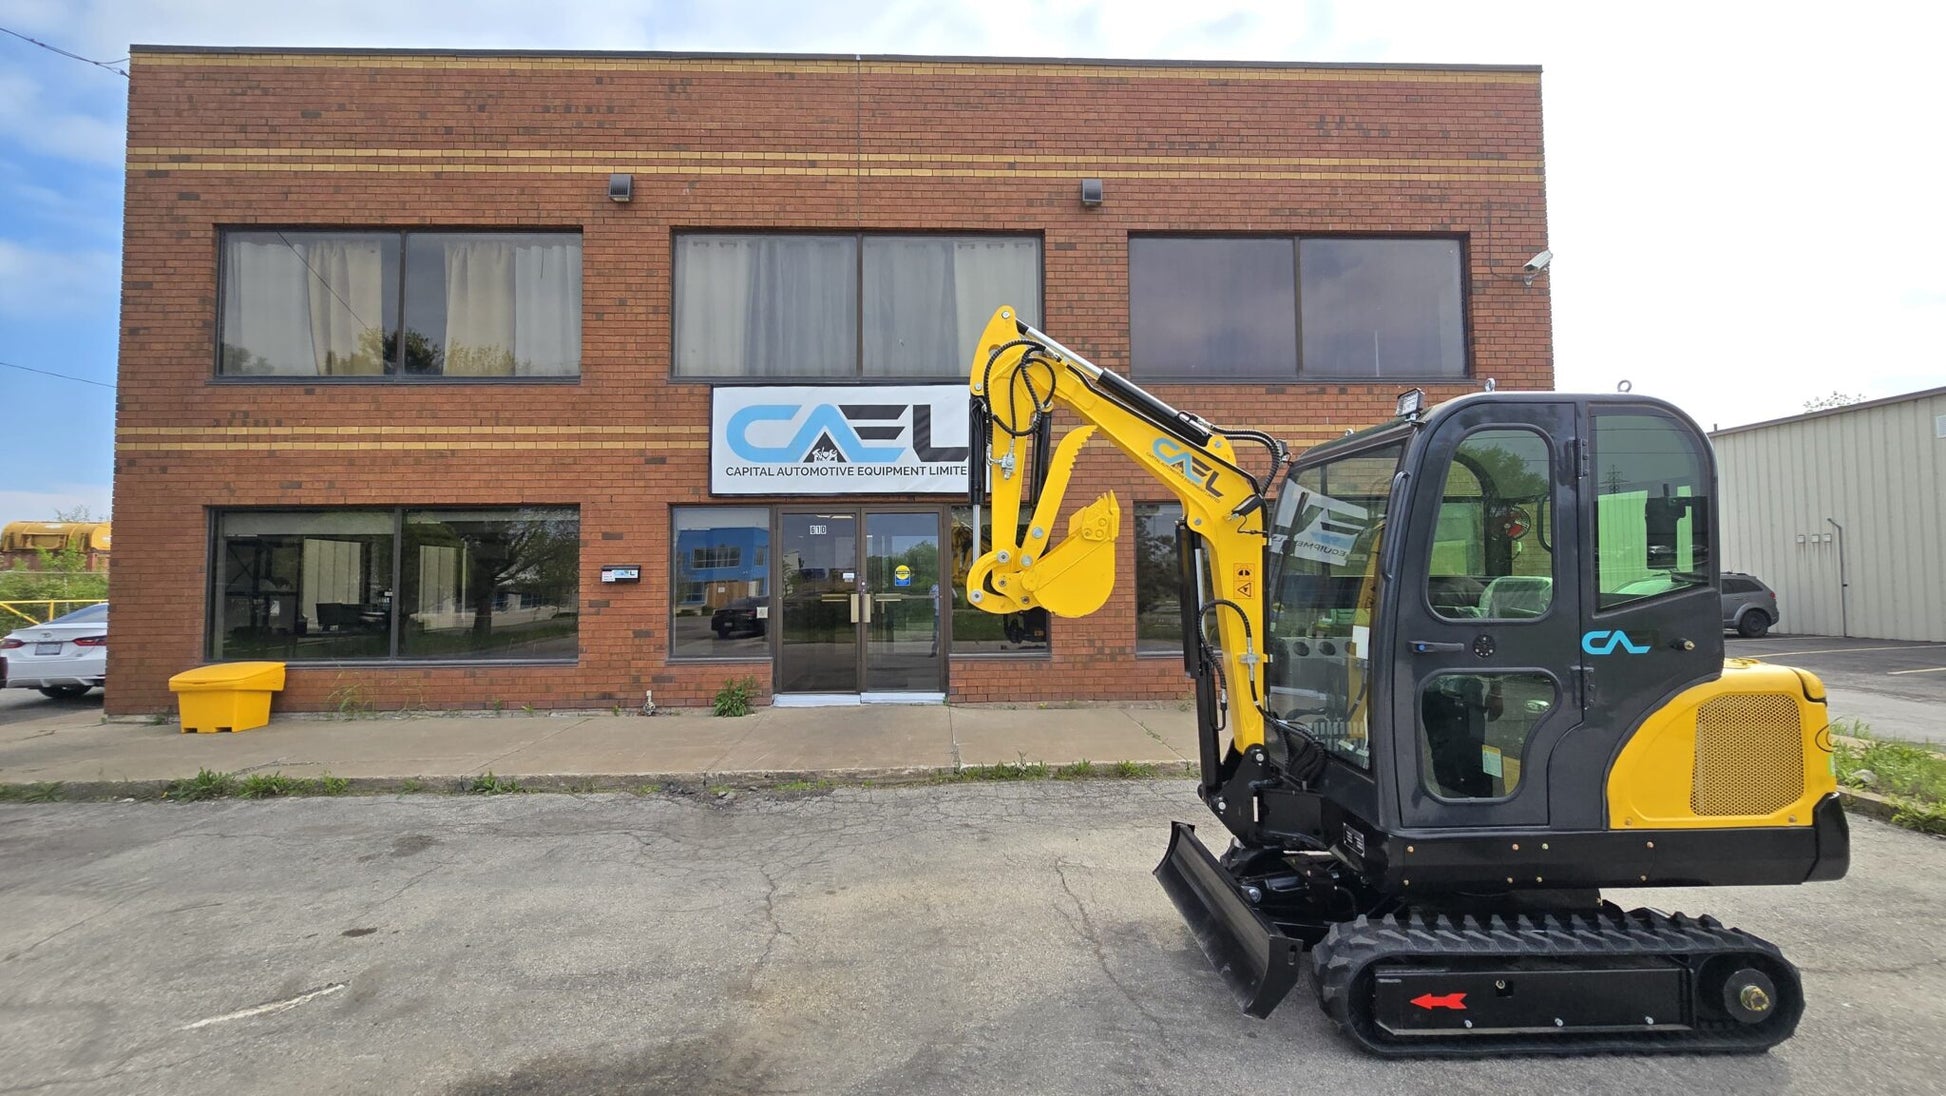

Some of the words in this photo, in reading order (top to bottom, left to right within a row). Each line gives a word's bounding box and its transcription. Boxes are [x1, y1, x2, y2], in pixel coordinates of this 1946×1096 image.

[726, 403, 968, 463] CAEL
[725, 466, 775, 477] CAPITAL
[776, 466, 855, 477] AUTOMOTIVE
[857, 465, 927, 476] EQUIPMENT
[929, 465, 967, 476] LIMITE
[1153, 437, 1224, 498] CAEL
